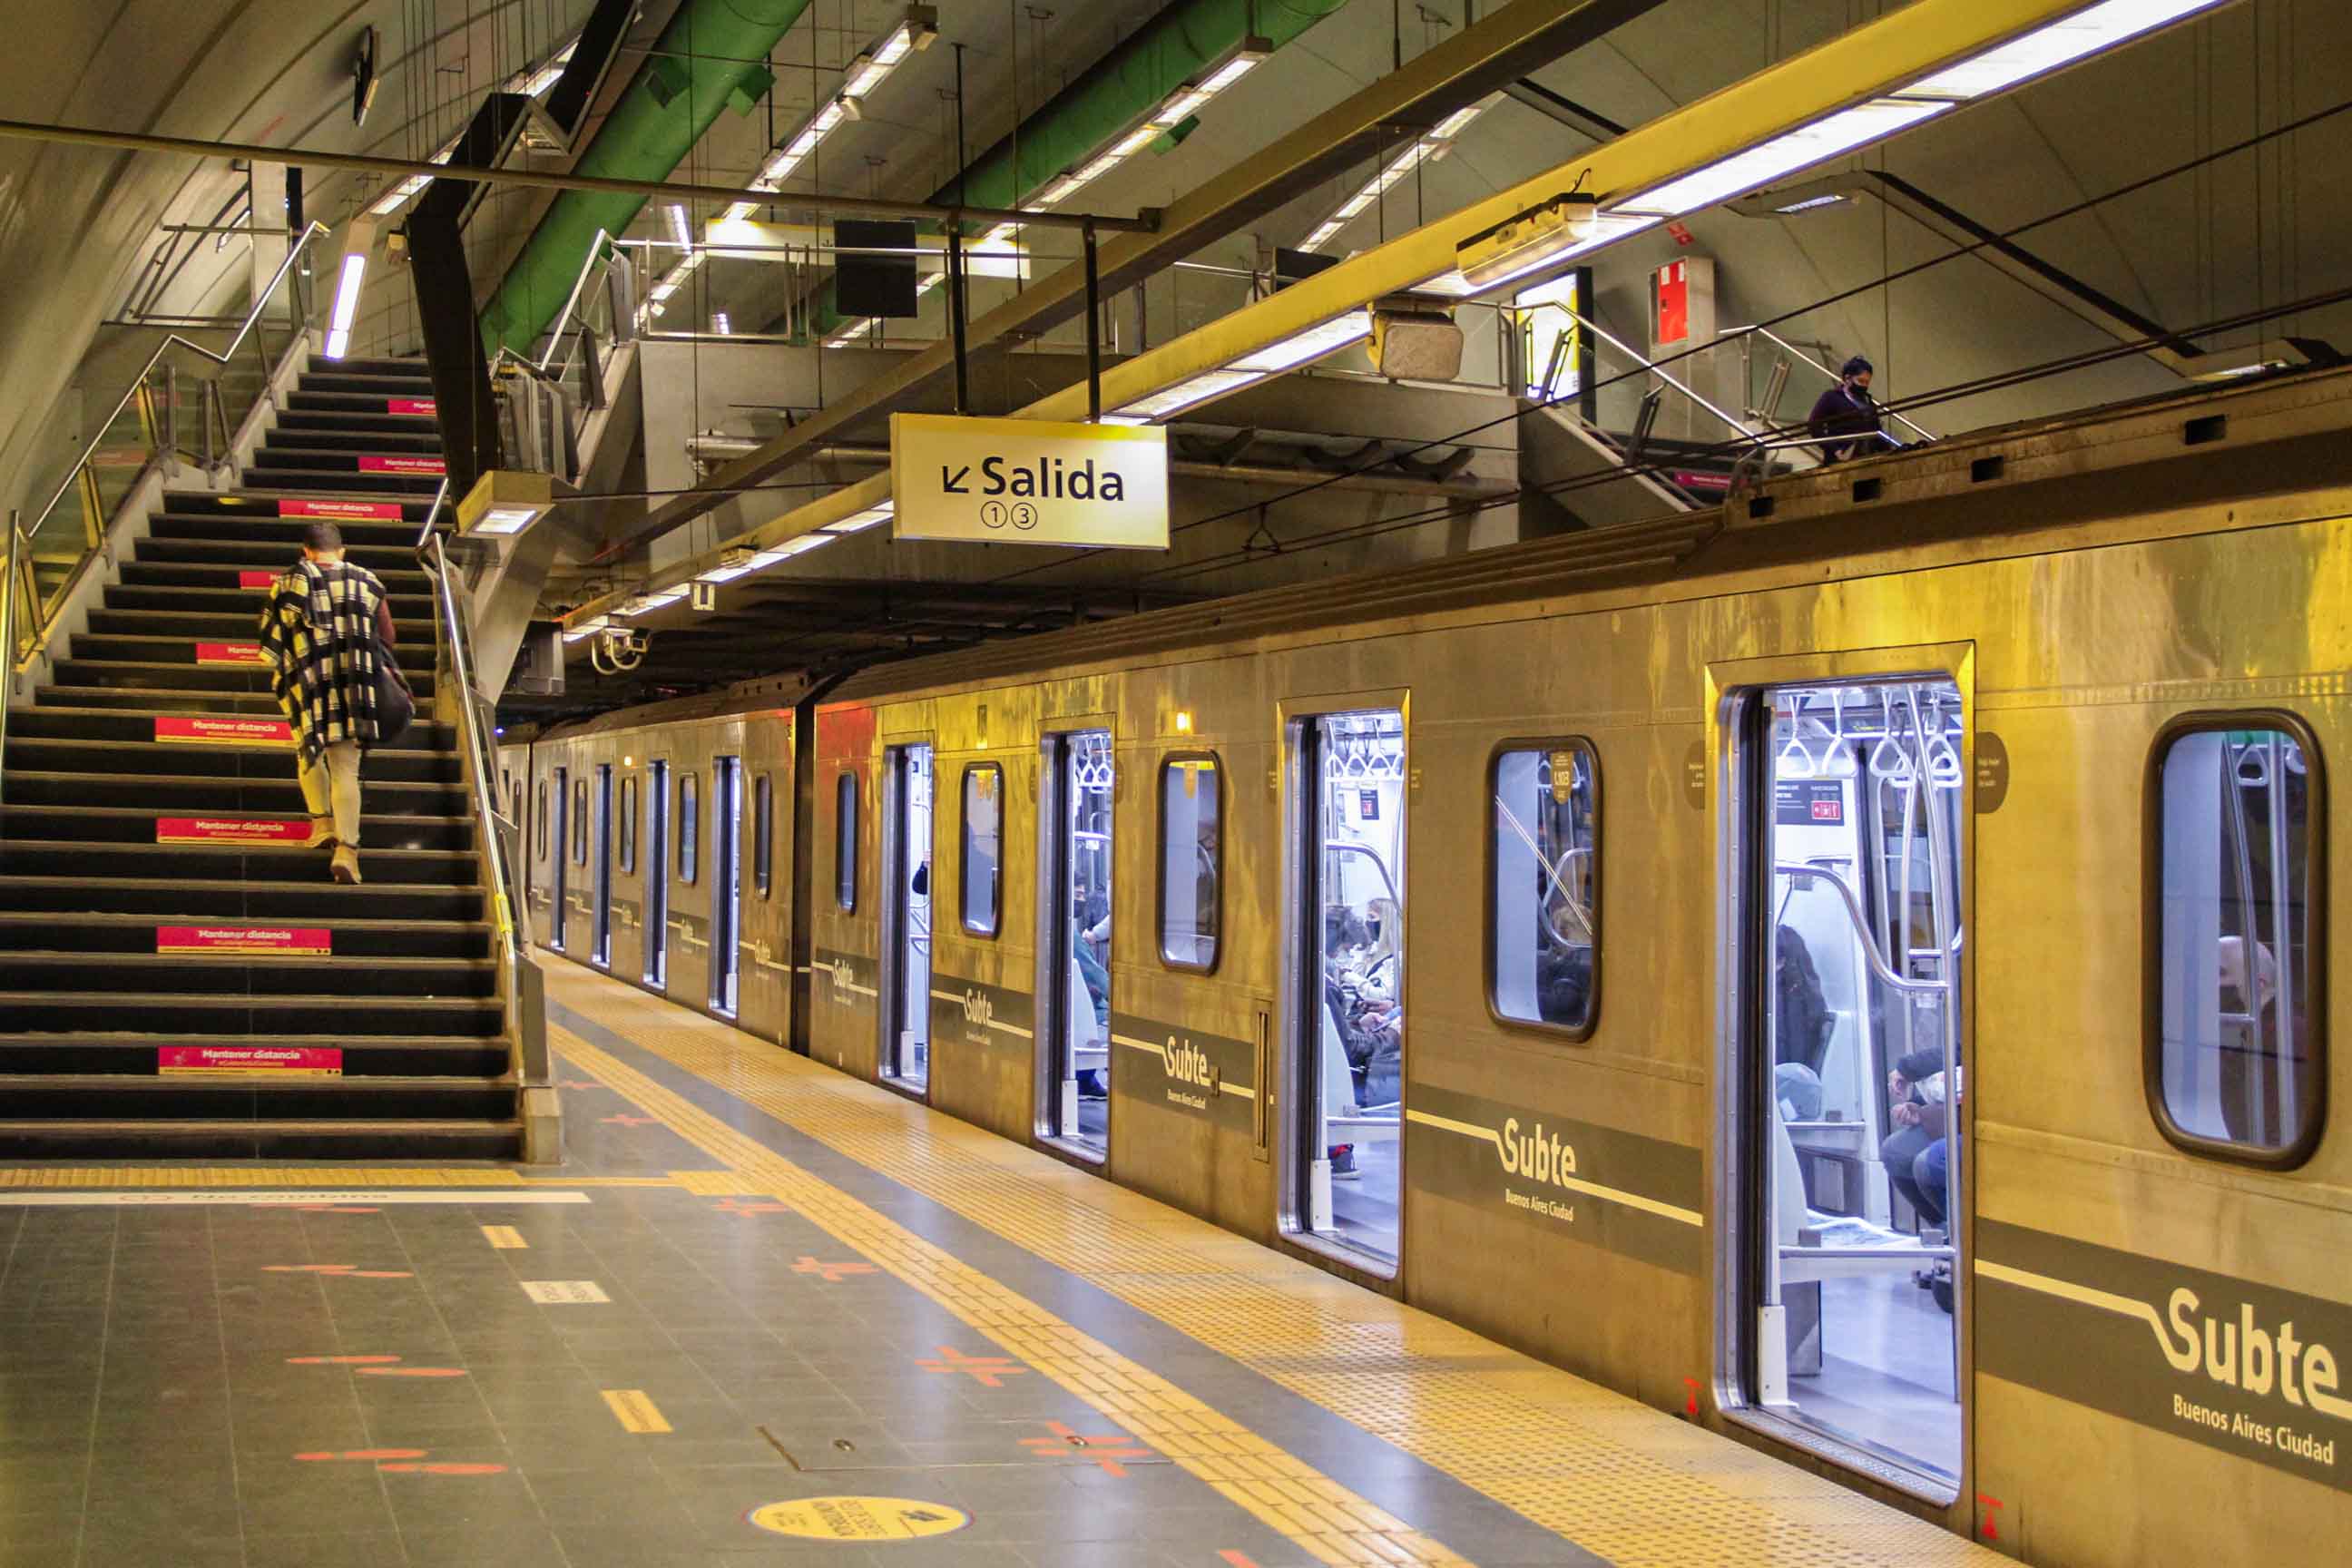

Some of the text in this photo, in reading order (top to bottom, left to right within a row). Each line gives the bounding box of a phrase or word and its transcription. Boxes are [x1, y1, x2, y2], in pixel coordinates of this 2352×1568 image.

[981, 456, 1124, 502] Salida
[196, 820, 284, 832] Mantener distancia
[198, 929, 291, 940] Mantener distancia
[965, 988, 993, 1027] Subte
[202, 1049, 300, 1060] Mantener distancia
[1165, 1035, 1208, 1086] Subte
[1503, 1117, 1577, 1189] Subte
[2167, 1287, 2338, 1411] Subte
[2173, 1394, 2335, 1466] Buenos Aires Ciudad
